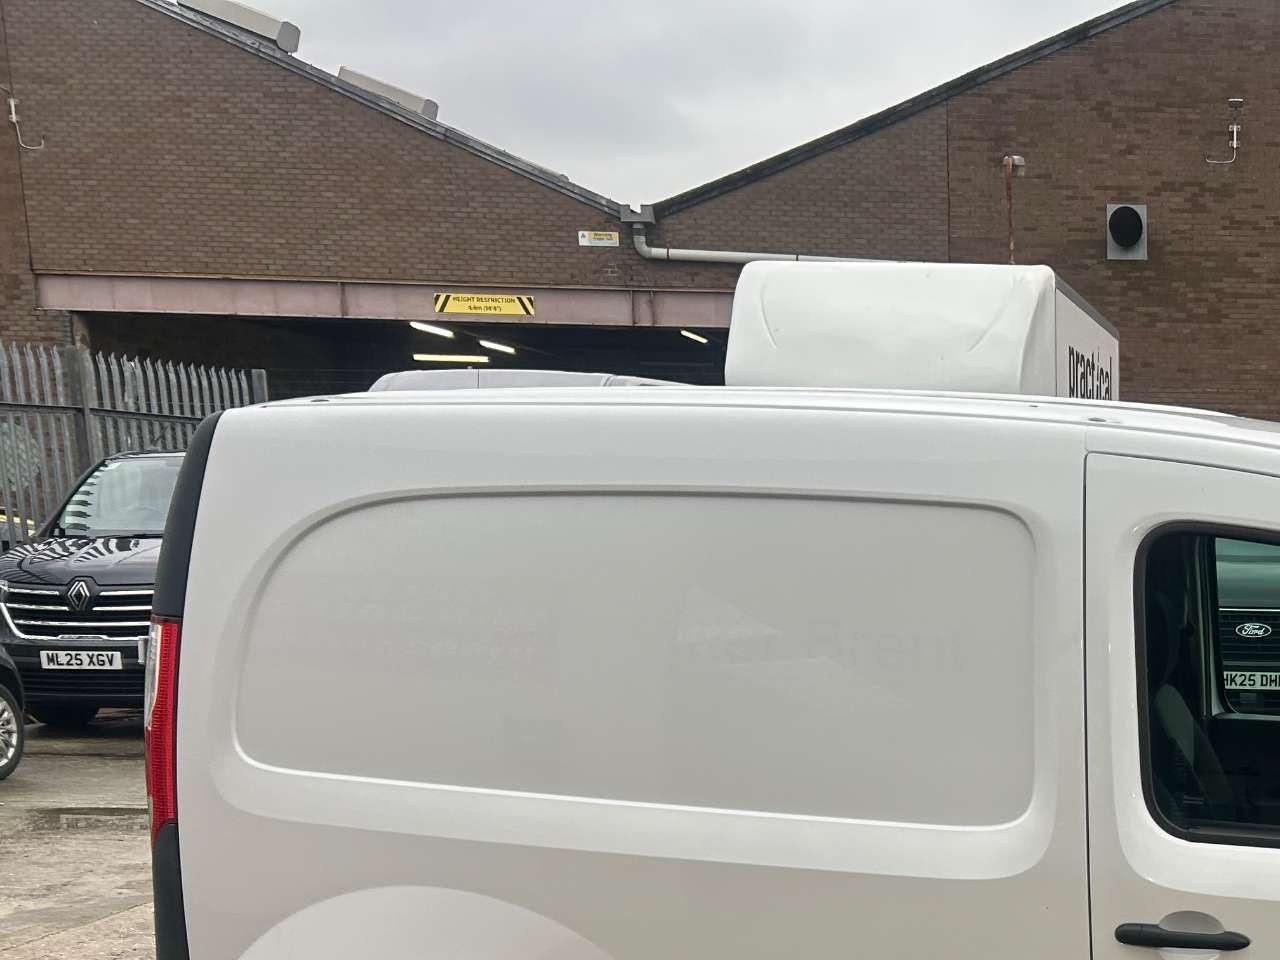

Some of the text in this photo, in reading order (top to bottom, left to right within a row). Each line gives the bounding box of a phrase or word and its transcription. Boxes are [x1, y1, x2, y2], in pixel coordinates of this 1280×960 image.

[476, 296, 516, 304] RESTRICTION
[1240, 624, 1267, 636] Ford
[46, 652, 114, 667] ML25 XGV
